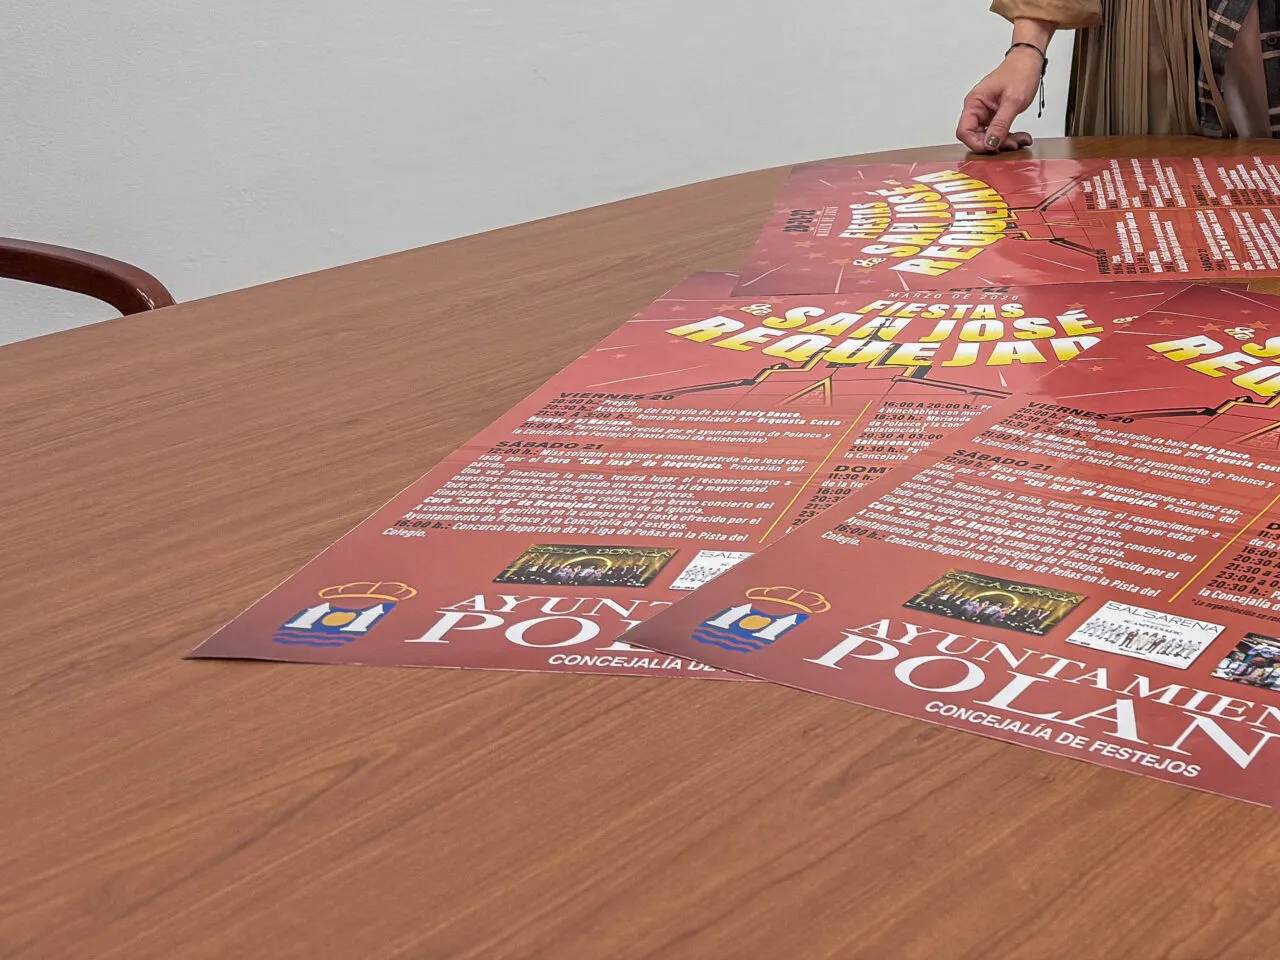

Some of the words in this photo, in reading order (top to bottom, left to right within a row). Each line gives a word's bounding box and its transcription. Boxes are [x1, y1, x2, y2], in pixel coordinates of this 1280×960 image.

[864, 184, 952, 218] JOSÉ
[838, 201, 892, 239] FIESTAS
[888, 170, 1010, 276] REQUEJADA
[861, 222, 946, 258] SAN
[855, 300, 1025, 320] FIESTAS
[766, 306, 908, 342] SAN
[924, 308, 1105, 342] JOSÉ
[1224, 326, 1256, 340] de
[1025, 401, 1113, 420] VIERNES
[1106, 415, 1135, 424] 20
[494, 440, 581, 448] SÁBADO
[951, 449, 1031, 467] SÁBADO
[1028, 462, 1053, 471] 21
[1241, 545, 1279, 558] 16:00
[1247, 538, 1264, 546] de
[1224, 562, 1263, 574] 21:30
[1233, 553, 1273, 566] 20:30
[1216, 570, 1257, 583] 23:00
[1207, 578, 1249, 592] 20:30
[1247, 586, 1270, 596] h.:
[1197, 587, 1212, 596] la
[1210, 590, 1272, 608] Concejalía
[1106, 602, 1219, 634] SALSARENA
[548, 654, 683, 672] CONCEJALÍA
[924, 700, 1052, 740] CONCEJALÍA
[1055, 732, 1084, 750] DE
[1088, 740, 1202, 778] FESTEJOS
